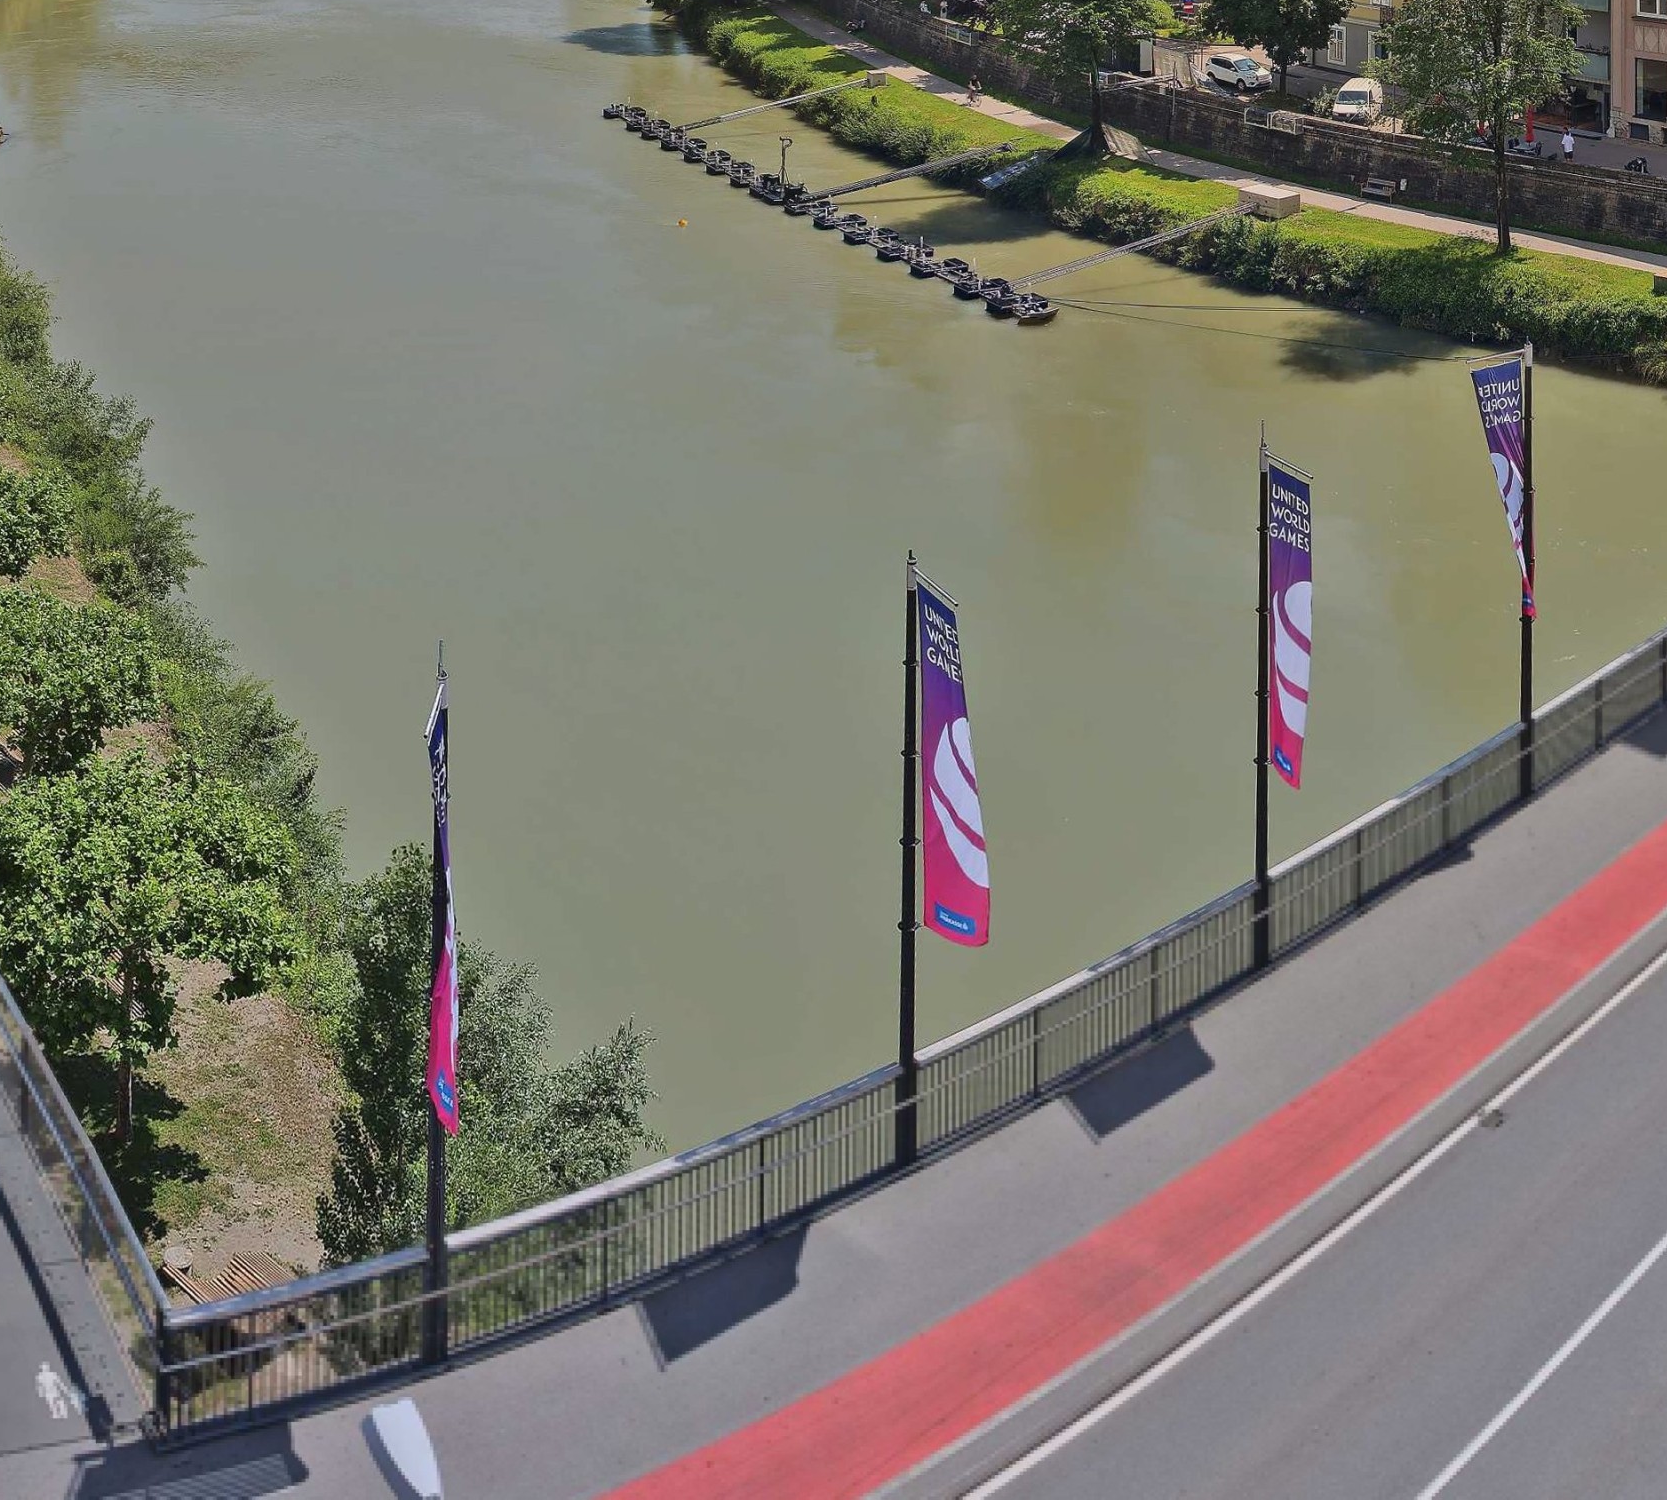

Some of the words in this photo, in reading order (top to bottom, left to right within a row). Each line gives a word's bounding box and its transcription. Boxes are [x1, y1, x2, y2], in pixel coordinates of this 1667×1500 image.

[1272, 483, 1309, 516] UNITED
[1270, 502, 1310, 534] WORLD
[1269, 522, 1310, 553] GAMES
